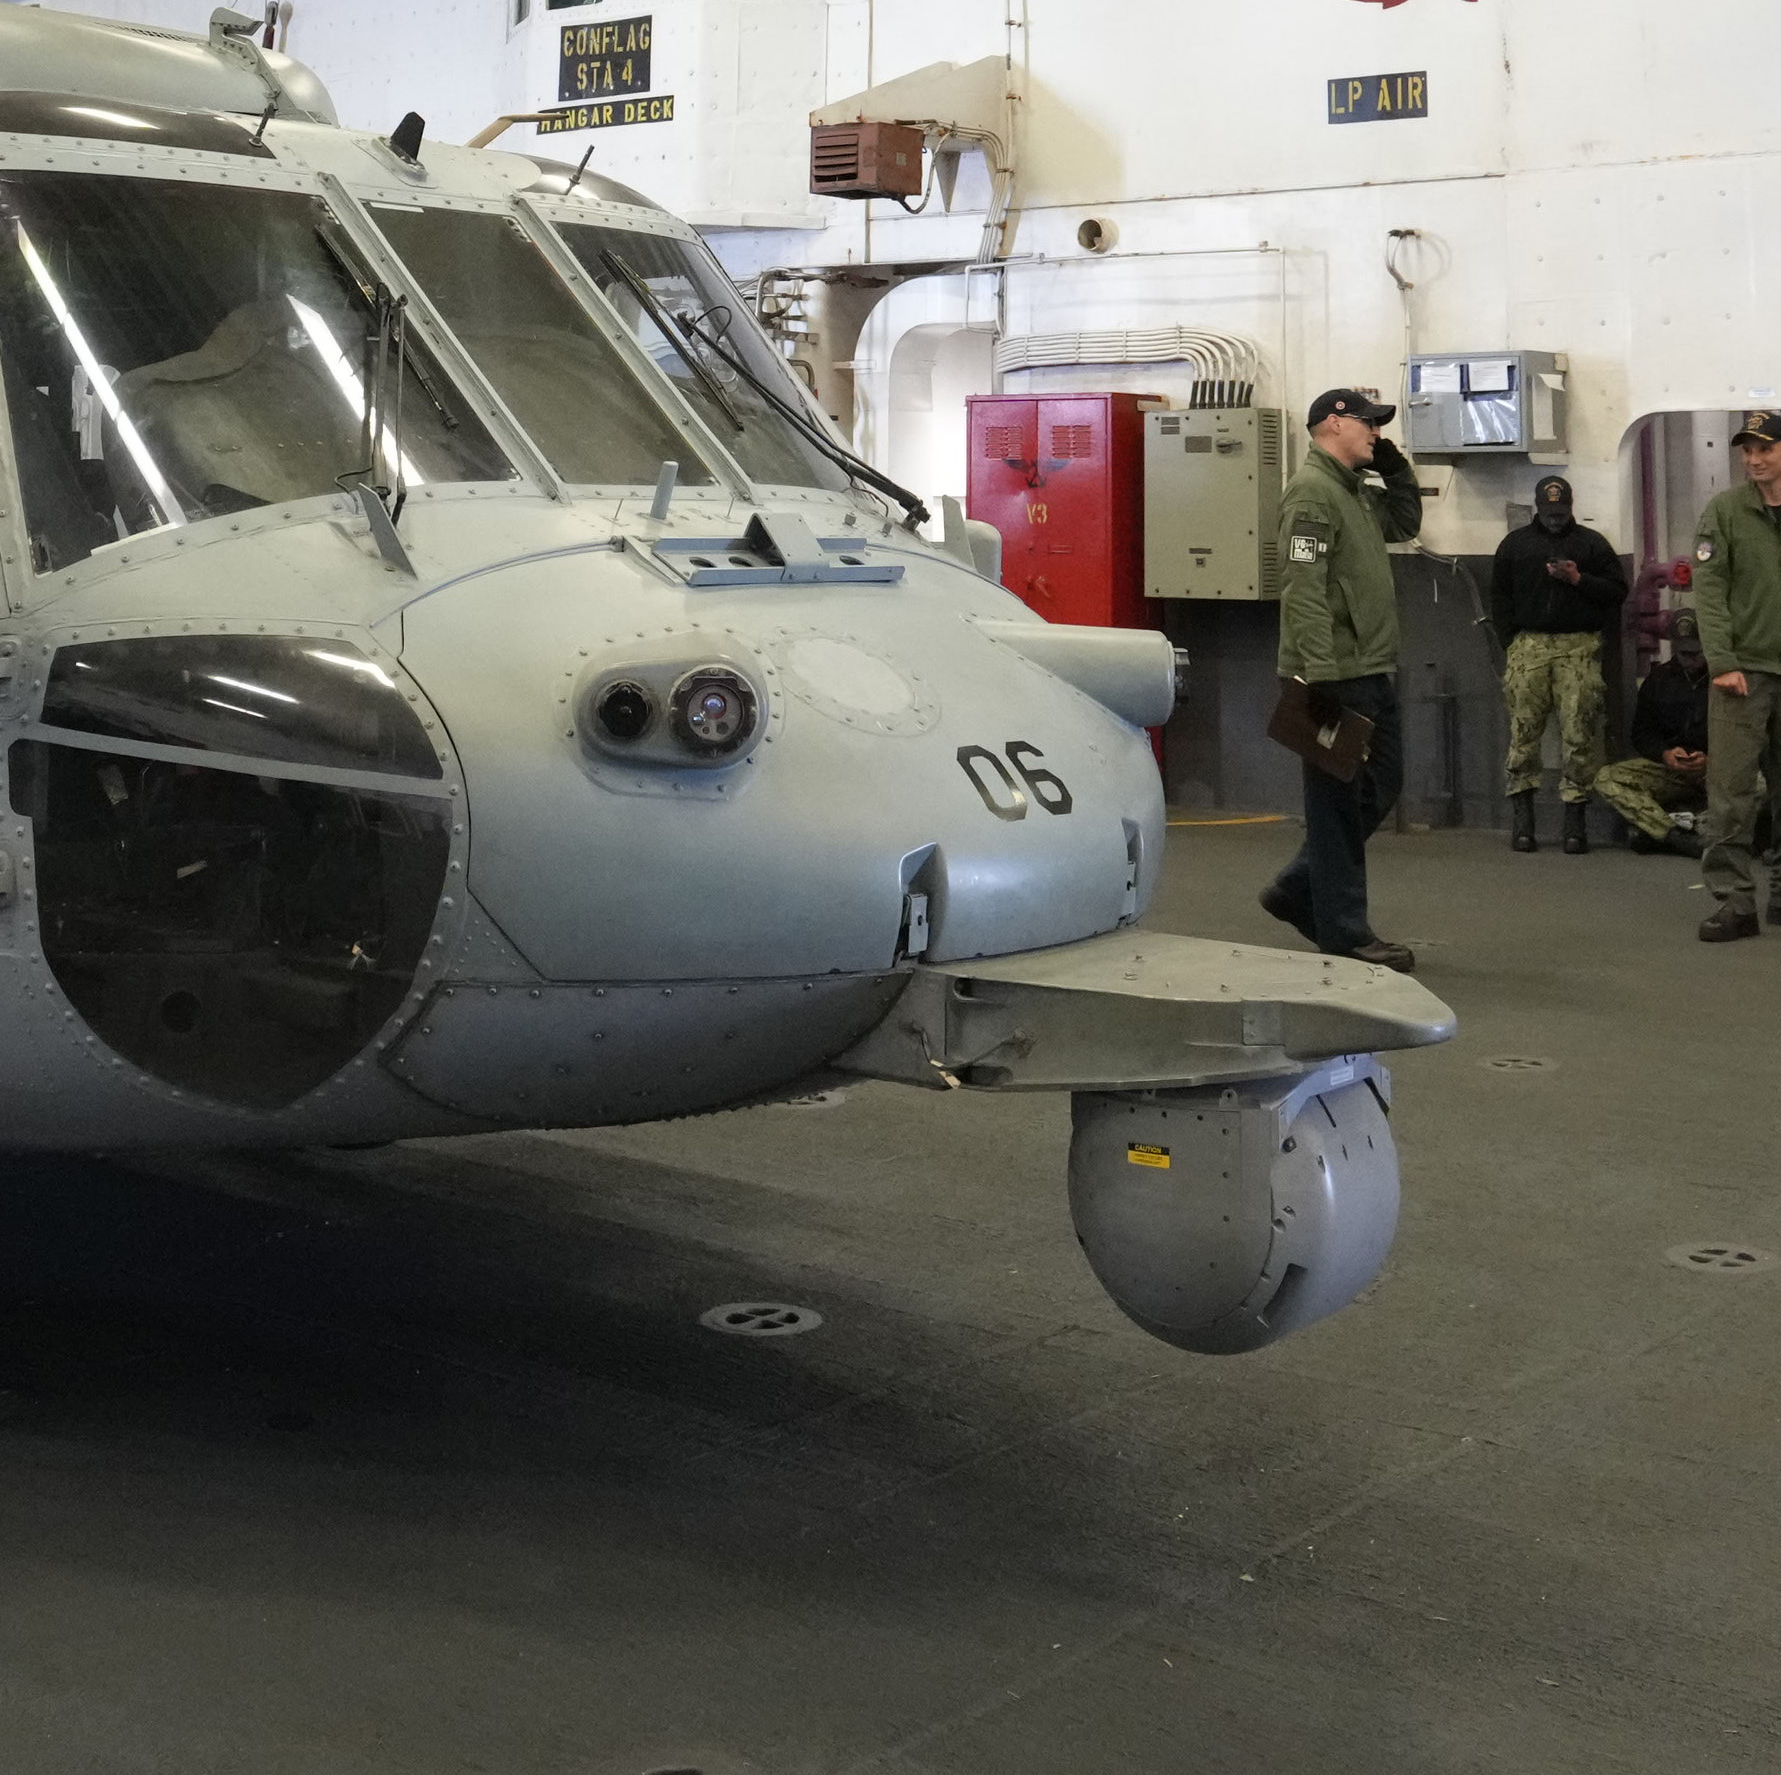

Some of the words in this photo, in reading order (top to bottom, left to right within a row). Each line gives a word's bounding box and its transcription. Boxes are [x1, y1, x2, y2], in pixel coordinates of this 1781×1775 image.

[563, 22, 651, 58] CONFLAG
[576, 60, 614, 91] STA
[621, 58, 634, 86] 4
[624, 97, 675, 124] DECK
[1330, 80, 1364, 115] LP
[1376, 75, 1423, 112] AIR
[1026, 503, 1048, 525] V3
[956, 740, 1073, 823] 06
